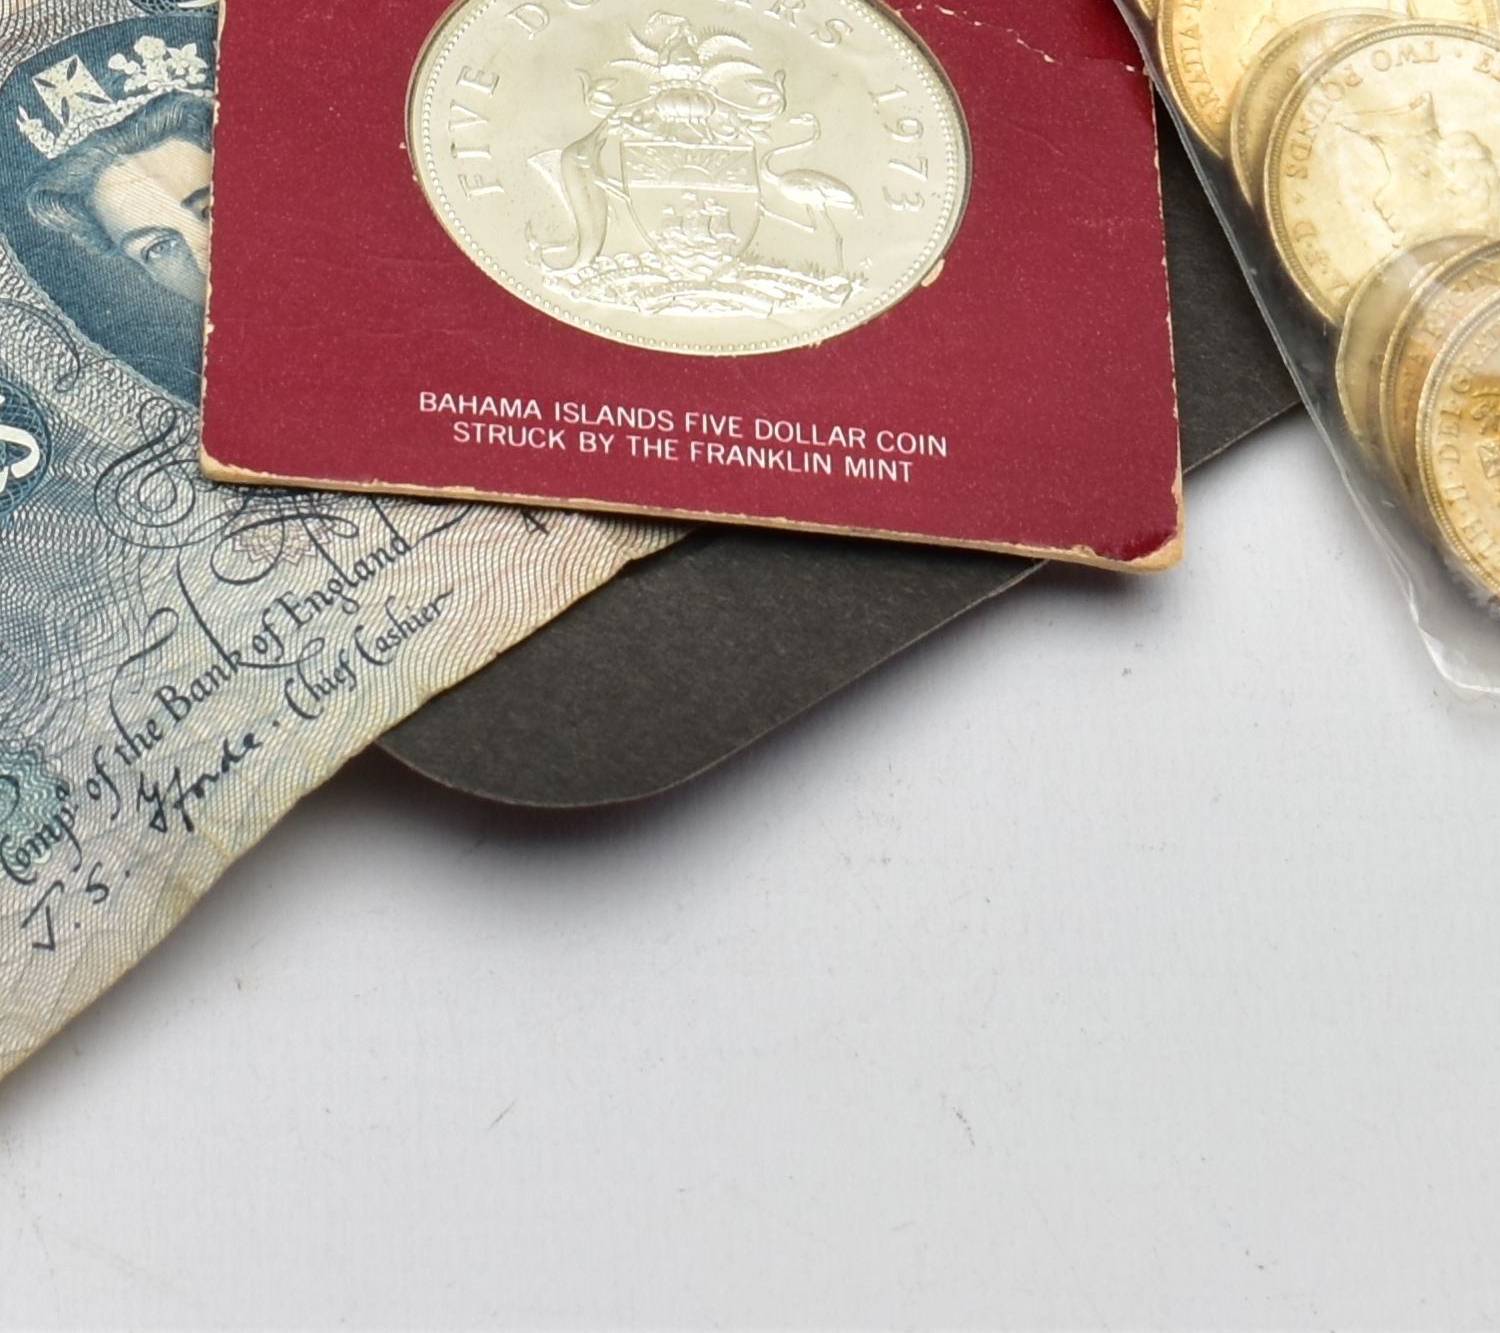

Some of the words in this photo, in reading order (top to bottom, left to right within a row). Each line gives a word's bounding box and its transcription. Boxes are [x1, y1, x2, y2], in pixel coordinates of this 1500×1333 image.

[1370, 39, 1441, 73] TWO
[448, 63, 505, 201] FIVE
[870, 83, 932, 215] 1973
[418, 391, 545, 421] BAHAMA
[553, 401, 677, 431] ISLANDS
[685, 410, 744, 439] FIVE
[754, 419, 868, 452] DOLLAR
[876, 430, 949, 459] COIN
[451, 420, 568, 450] STRUCK
[578, 428, 618, 454] BY
[625, 433, 681, 461] THE
[690, 438, 833, 476] FRANKLIN
[842, 453, 915, 485] MINT
[85, 745, 124, 823] of
[112, 715, 160, 770] the
[156, 650, 245, 727] Bank
[250, 613, 288, 665] of
[284, 533, 413, 630] England
[284, 661, 358, 725] Chief
[354, 587, 454, 670] Cashier
